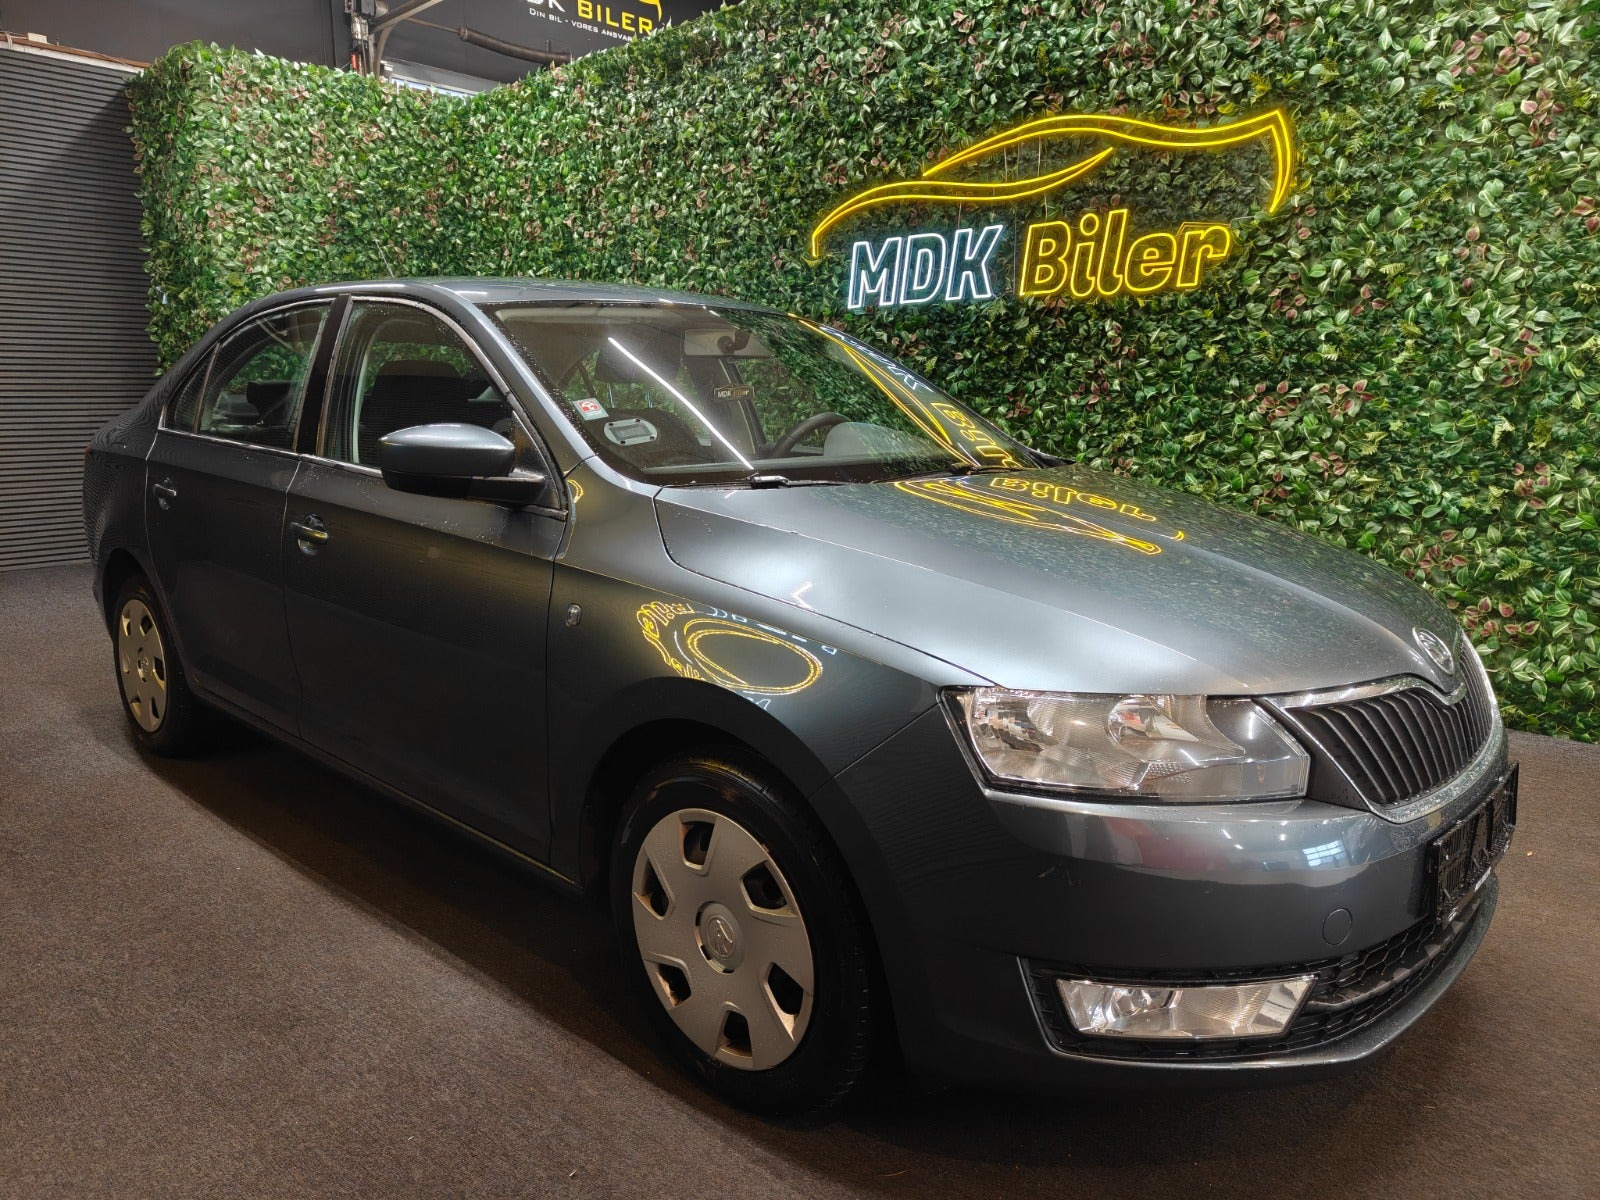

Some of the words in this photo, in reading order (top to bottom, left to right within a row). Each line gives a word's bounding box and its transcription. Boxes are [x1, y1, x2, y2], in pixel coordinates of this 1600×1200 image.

[529, 7, 546, 19] DIN
[548, 13, 563, 24] BIL
[571, 20, 599, 33] VORES
[601, 28, 633, 42] ANSVAR
[577, 0, 653, 36] BILER
[847, 223, 1003, 310] MDK
[1018, 208, 1232, 299] Biler
